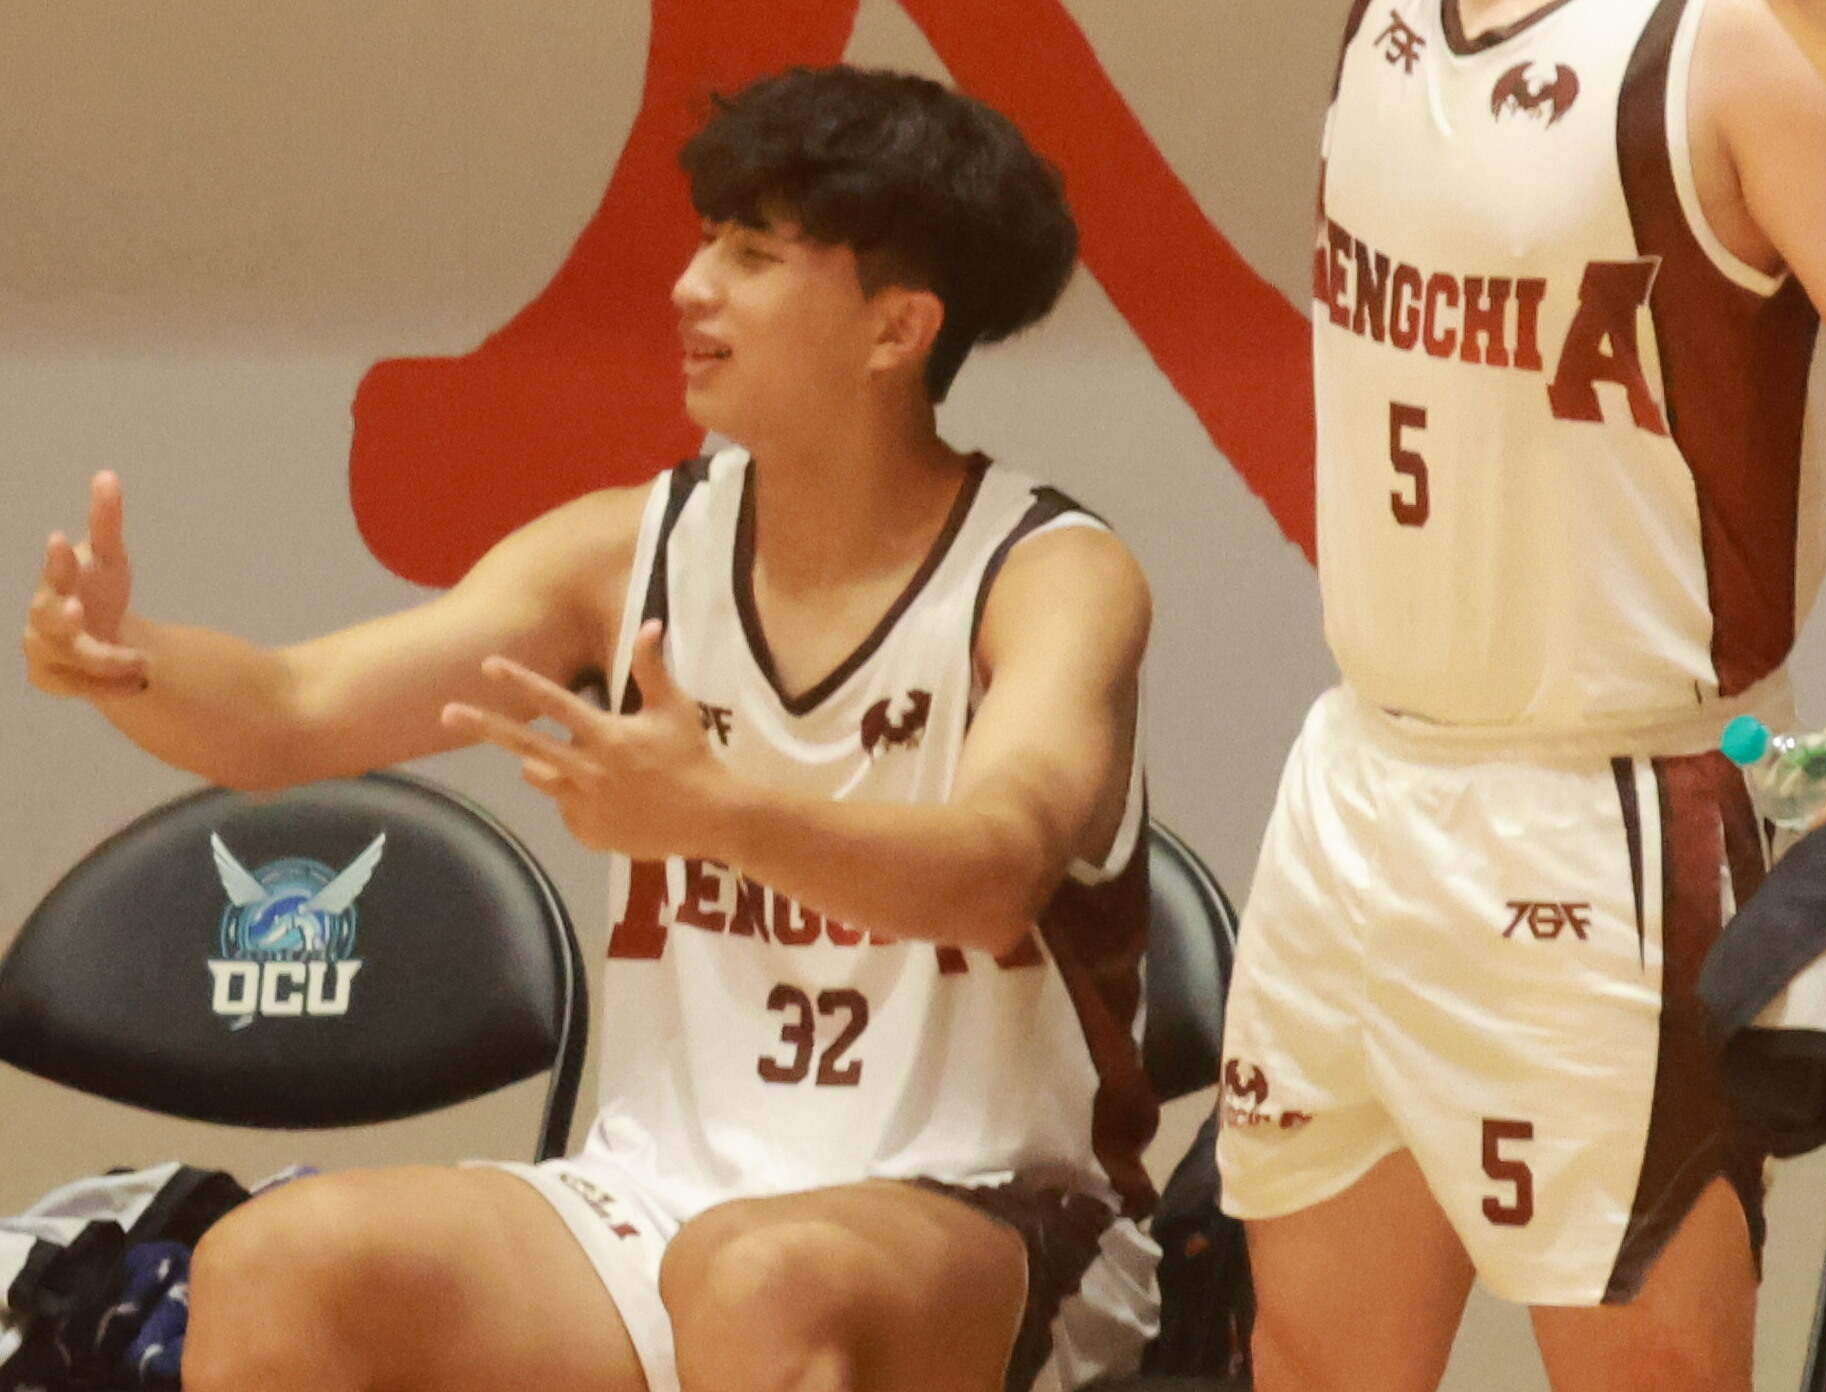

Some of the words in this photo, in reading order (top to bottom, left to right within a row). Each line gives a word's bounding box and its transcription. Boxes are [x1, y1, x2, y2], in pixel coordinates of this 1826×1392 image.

[1389, 401, 1431, 527] 5
[757, 983, 870, 1087] 32
[1481, 1119, 1534, 1227] 5
